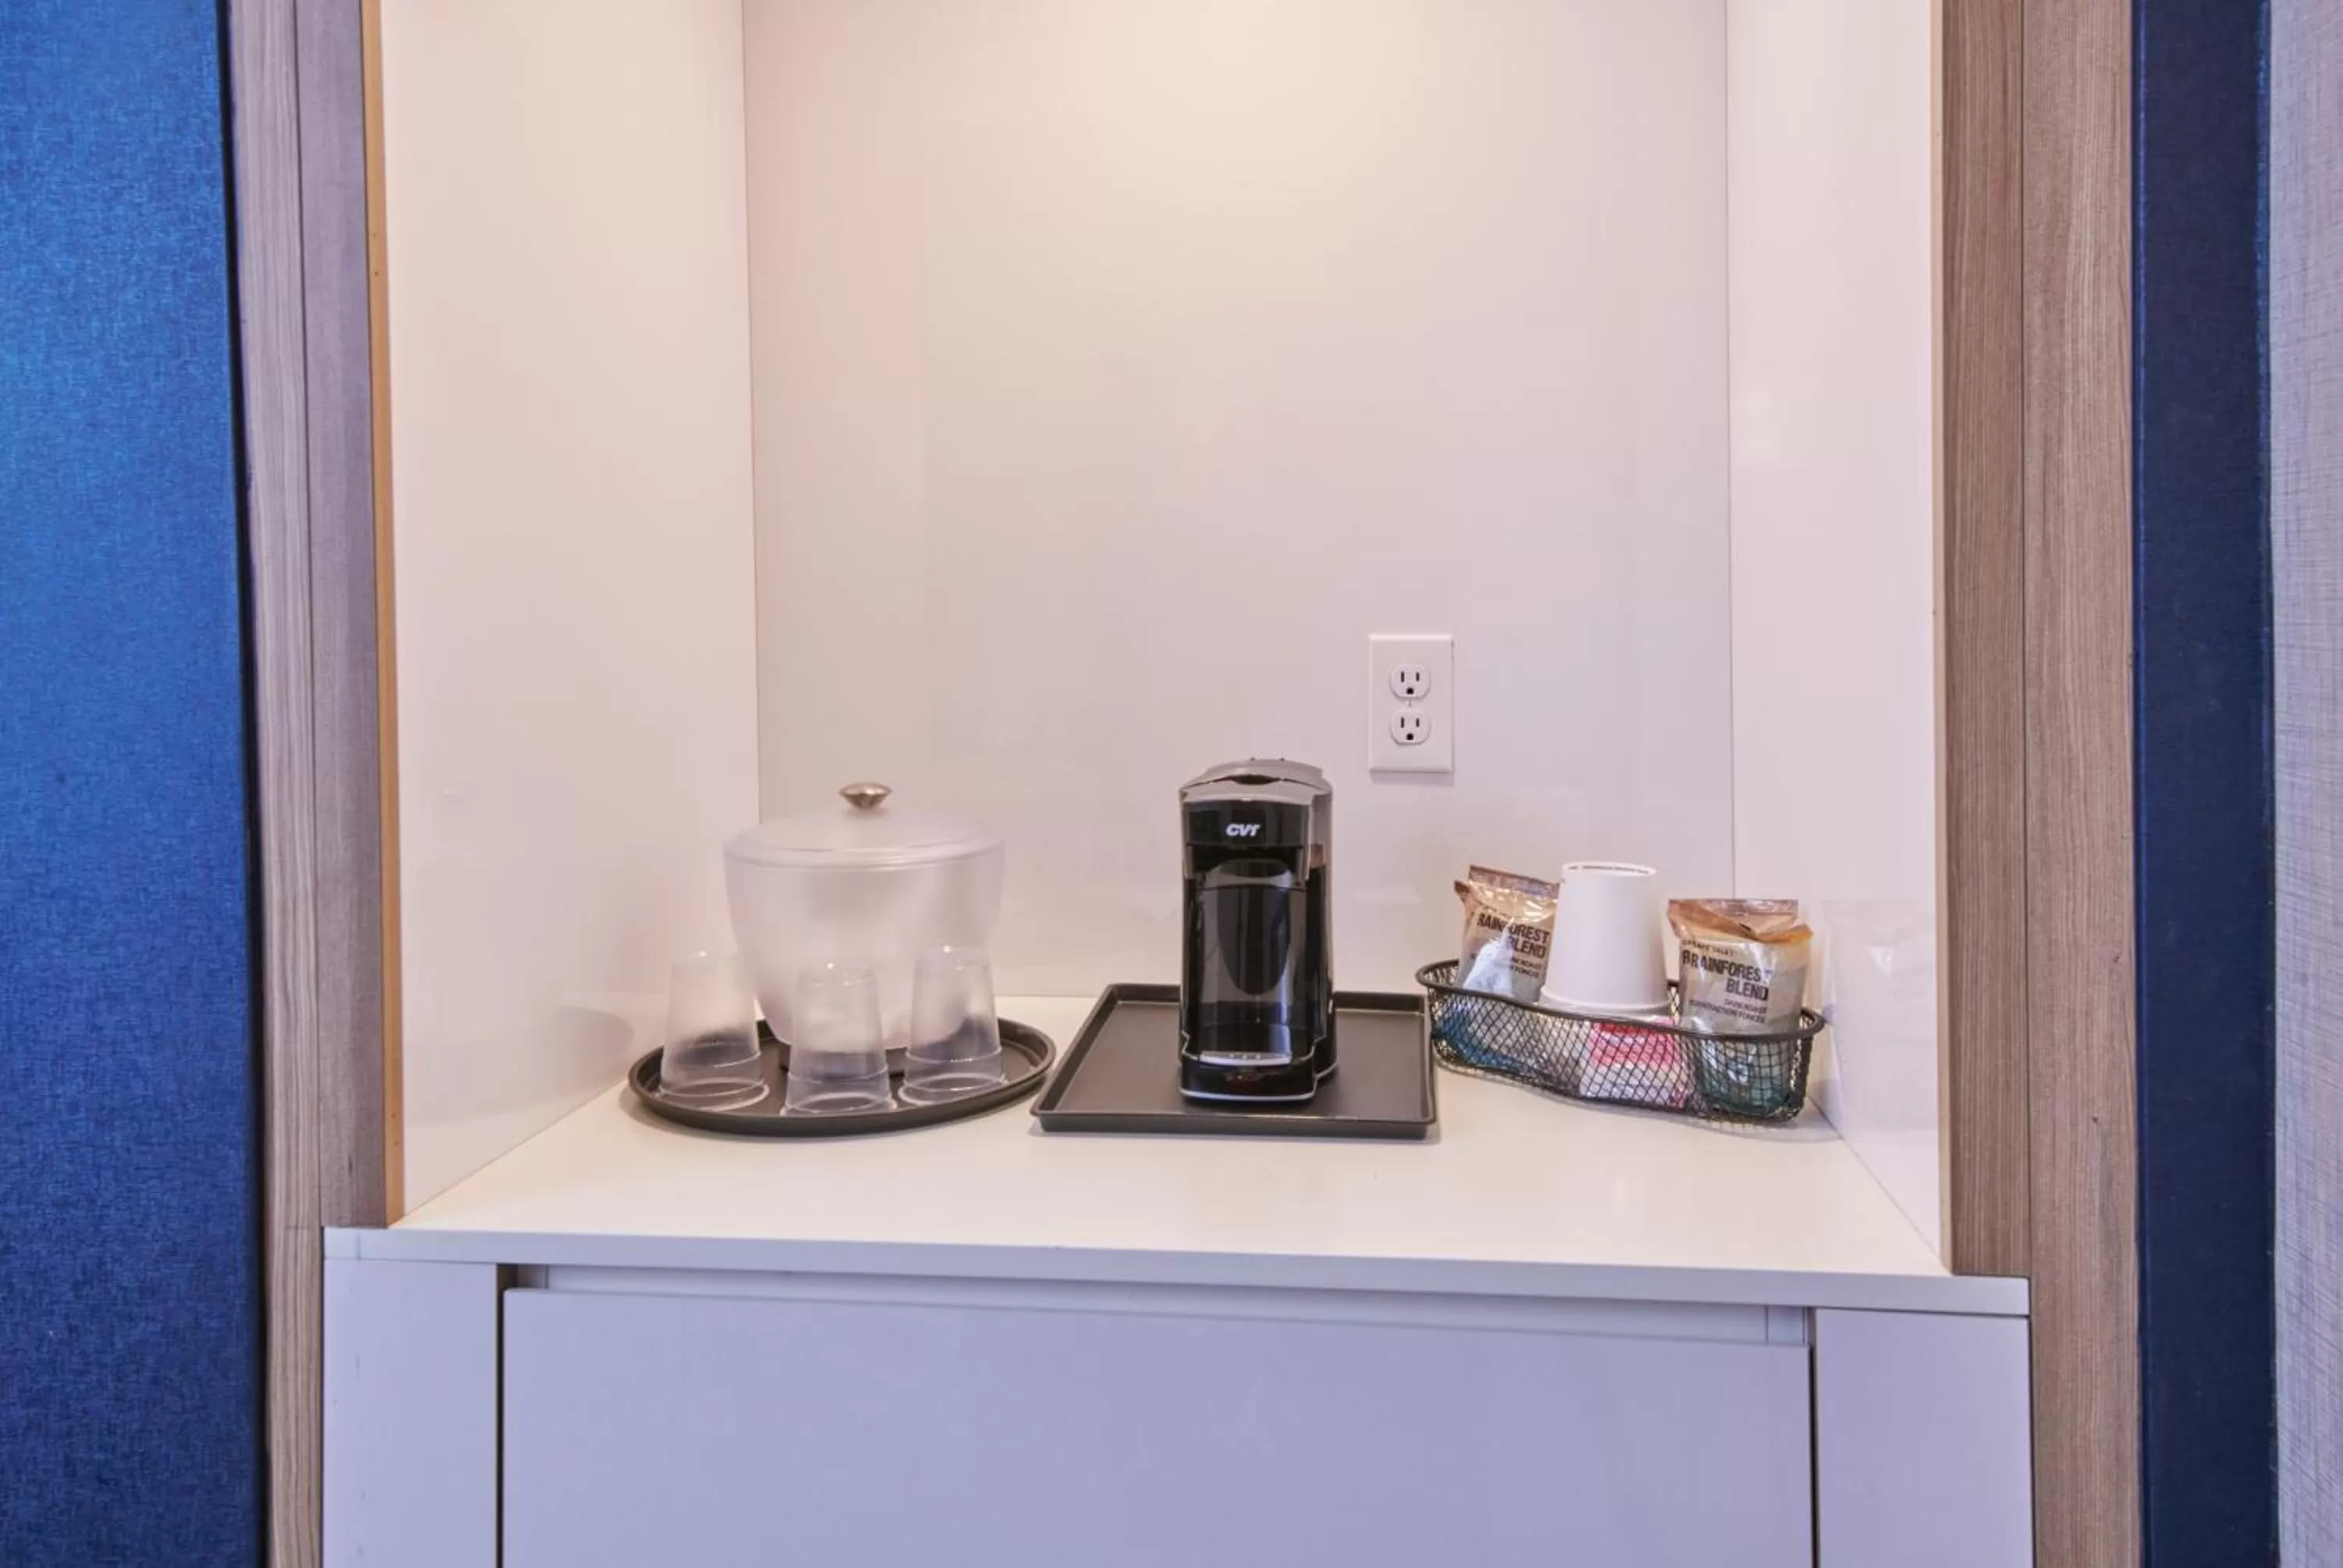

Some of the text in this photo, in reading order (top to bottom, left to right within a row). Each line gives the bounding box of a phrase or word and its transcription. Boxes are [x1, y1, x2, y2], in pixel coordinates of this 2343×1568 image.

[1225, 823, 1261, 836] CVT
[1477, 911, 1550, 943] RAINOREST
[1725, 978, 1768, 1001] BLEND
